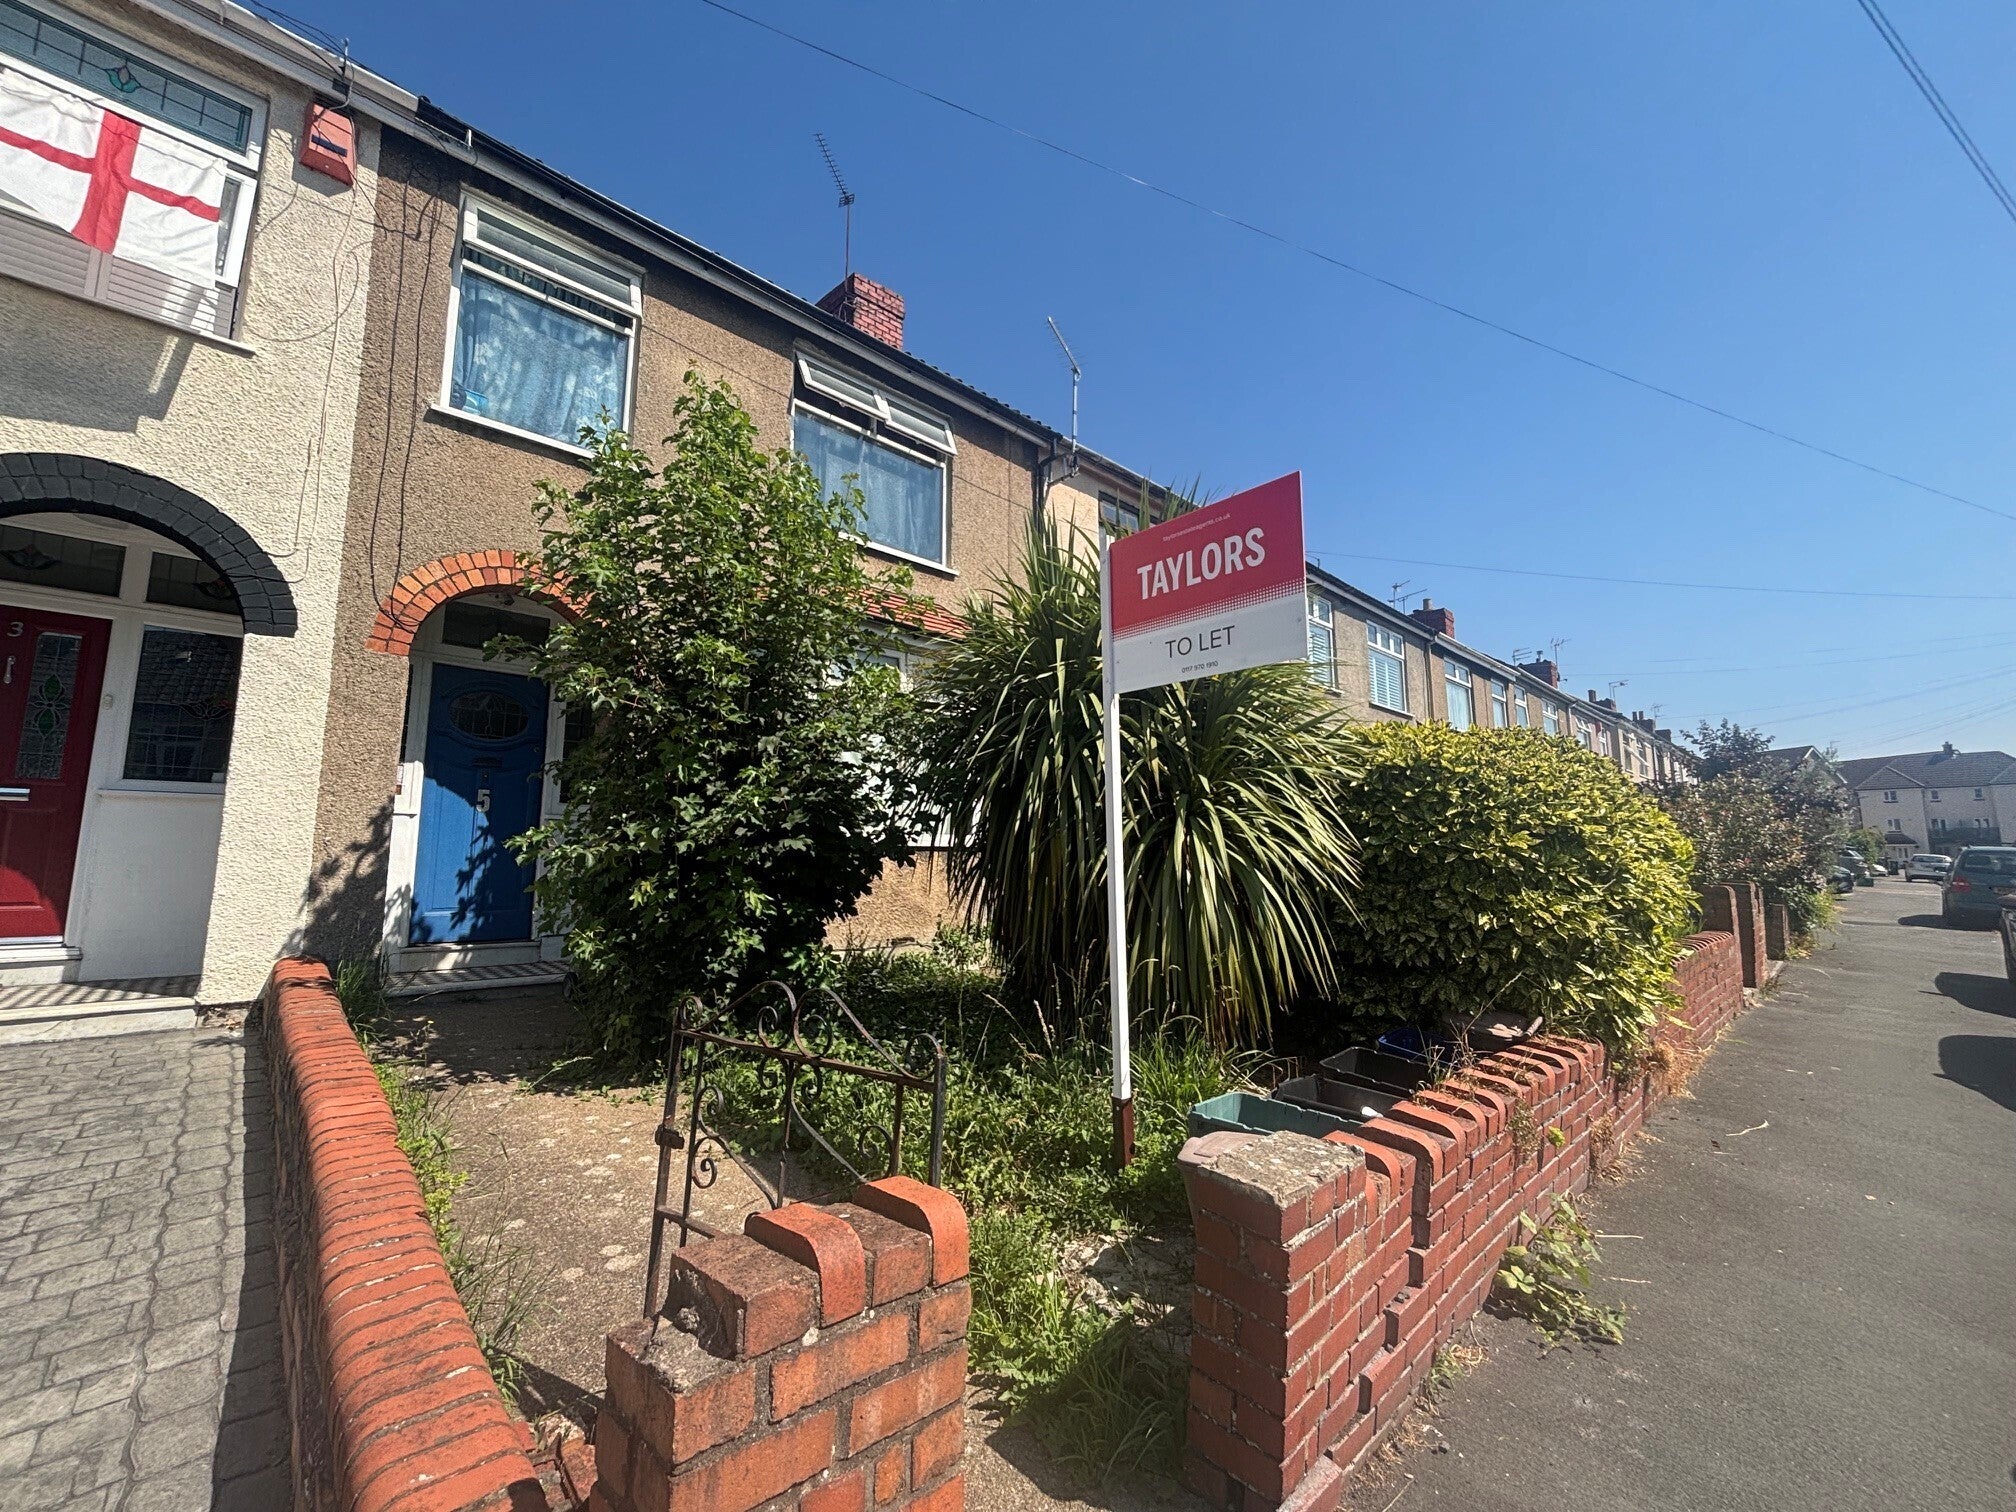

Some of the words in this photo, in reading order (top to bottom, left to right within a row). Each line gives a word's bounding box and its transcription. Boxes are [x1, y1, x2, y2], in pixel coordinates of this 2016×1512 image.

[1137, 527, 1266, 600] TAYLORS
[6, 621, 24, 637] 3
[1165, 636, 1192, 659] TO
[1198, 625, 1235, 652] LET
[1181, 665, 1193, 674] 0117
[475, 789, 491, 813] 5
